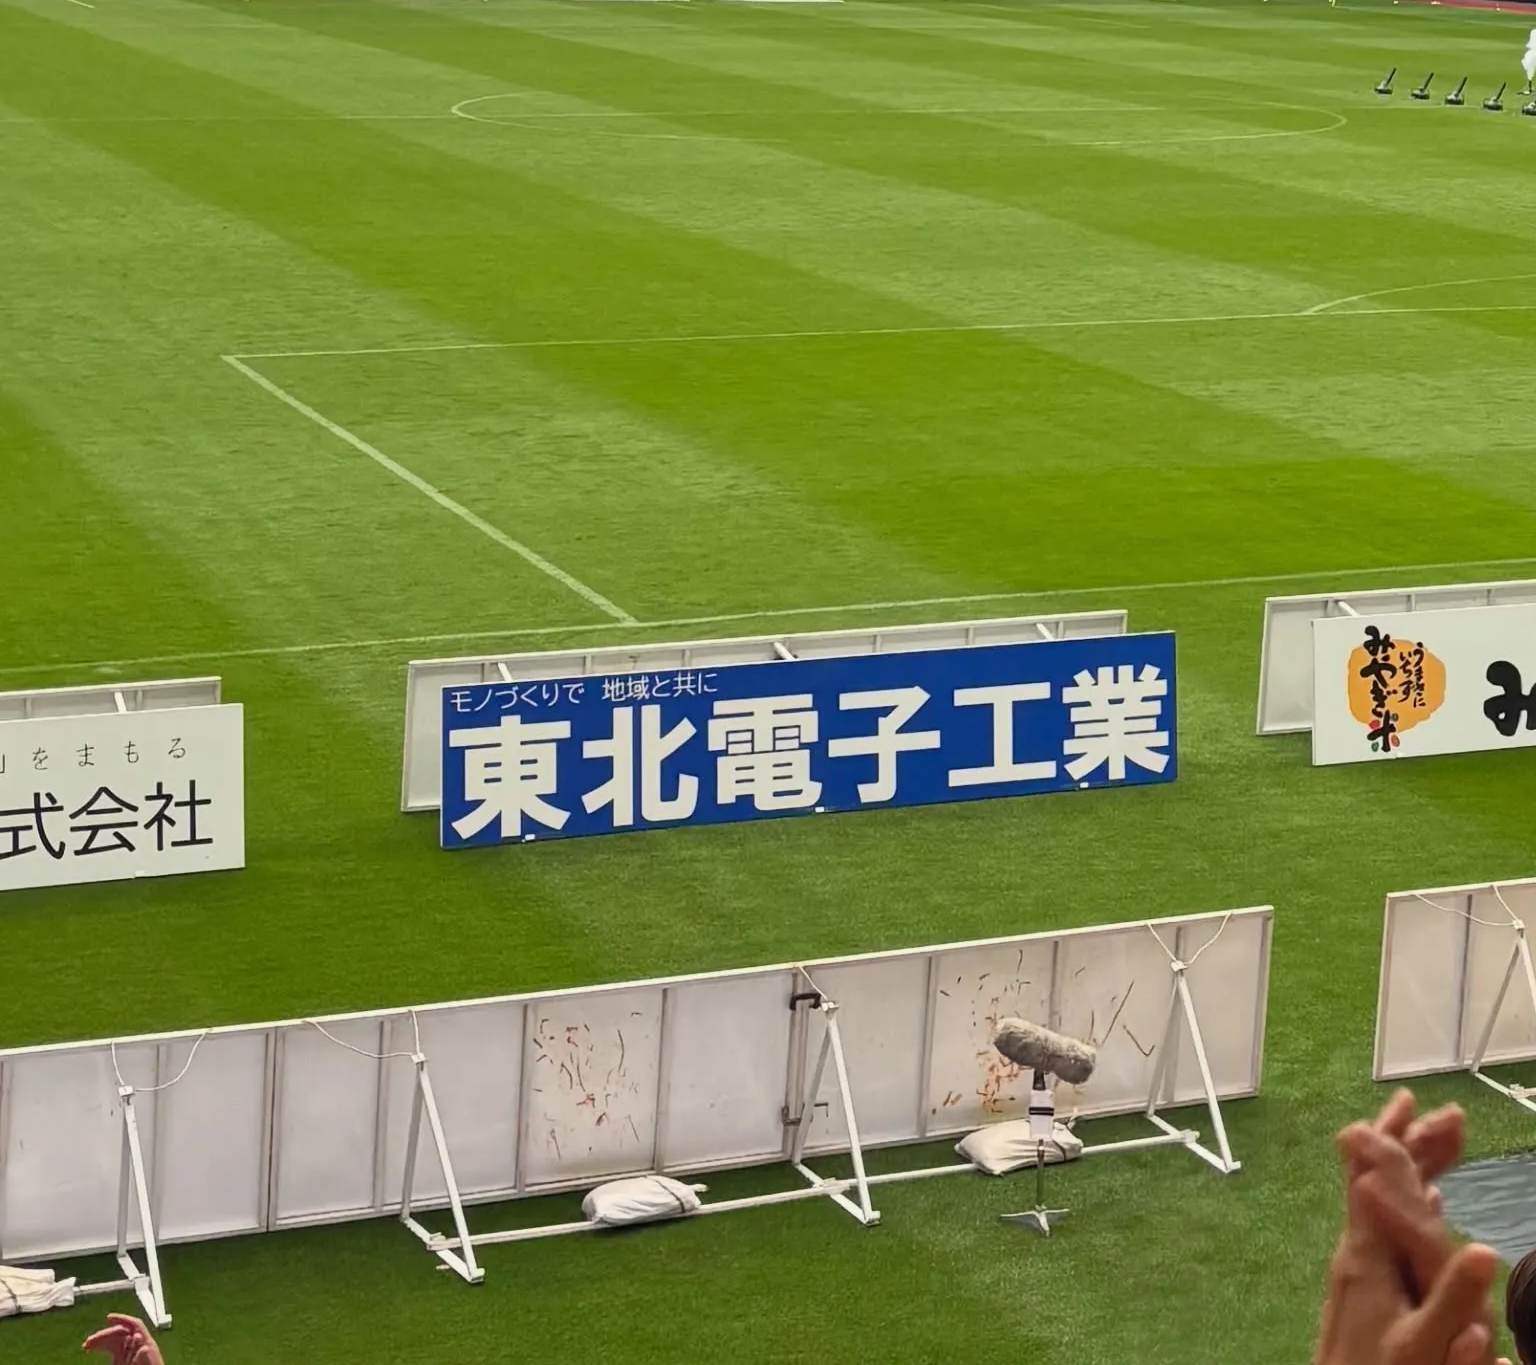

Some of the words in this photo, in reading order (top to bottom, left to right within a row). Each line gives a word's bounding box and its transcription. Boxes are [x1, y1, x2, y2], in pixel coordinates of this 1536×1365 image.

[450, 682, 585, 712] モノづくりで
[601, 671, 718, 701] 地域と共に
[1360, 625, 1399, 752] みやぎ米
[0, 737, 186, 774] をまもる
[447, 663, 1170, 840] 東北電子工業
[0, 779, 213, 860] 式会社
